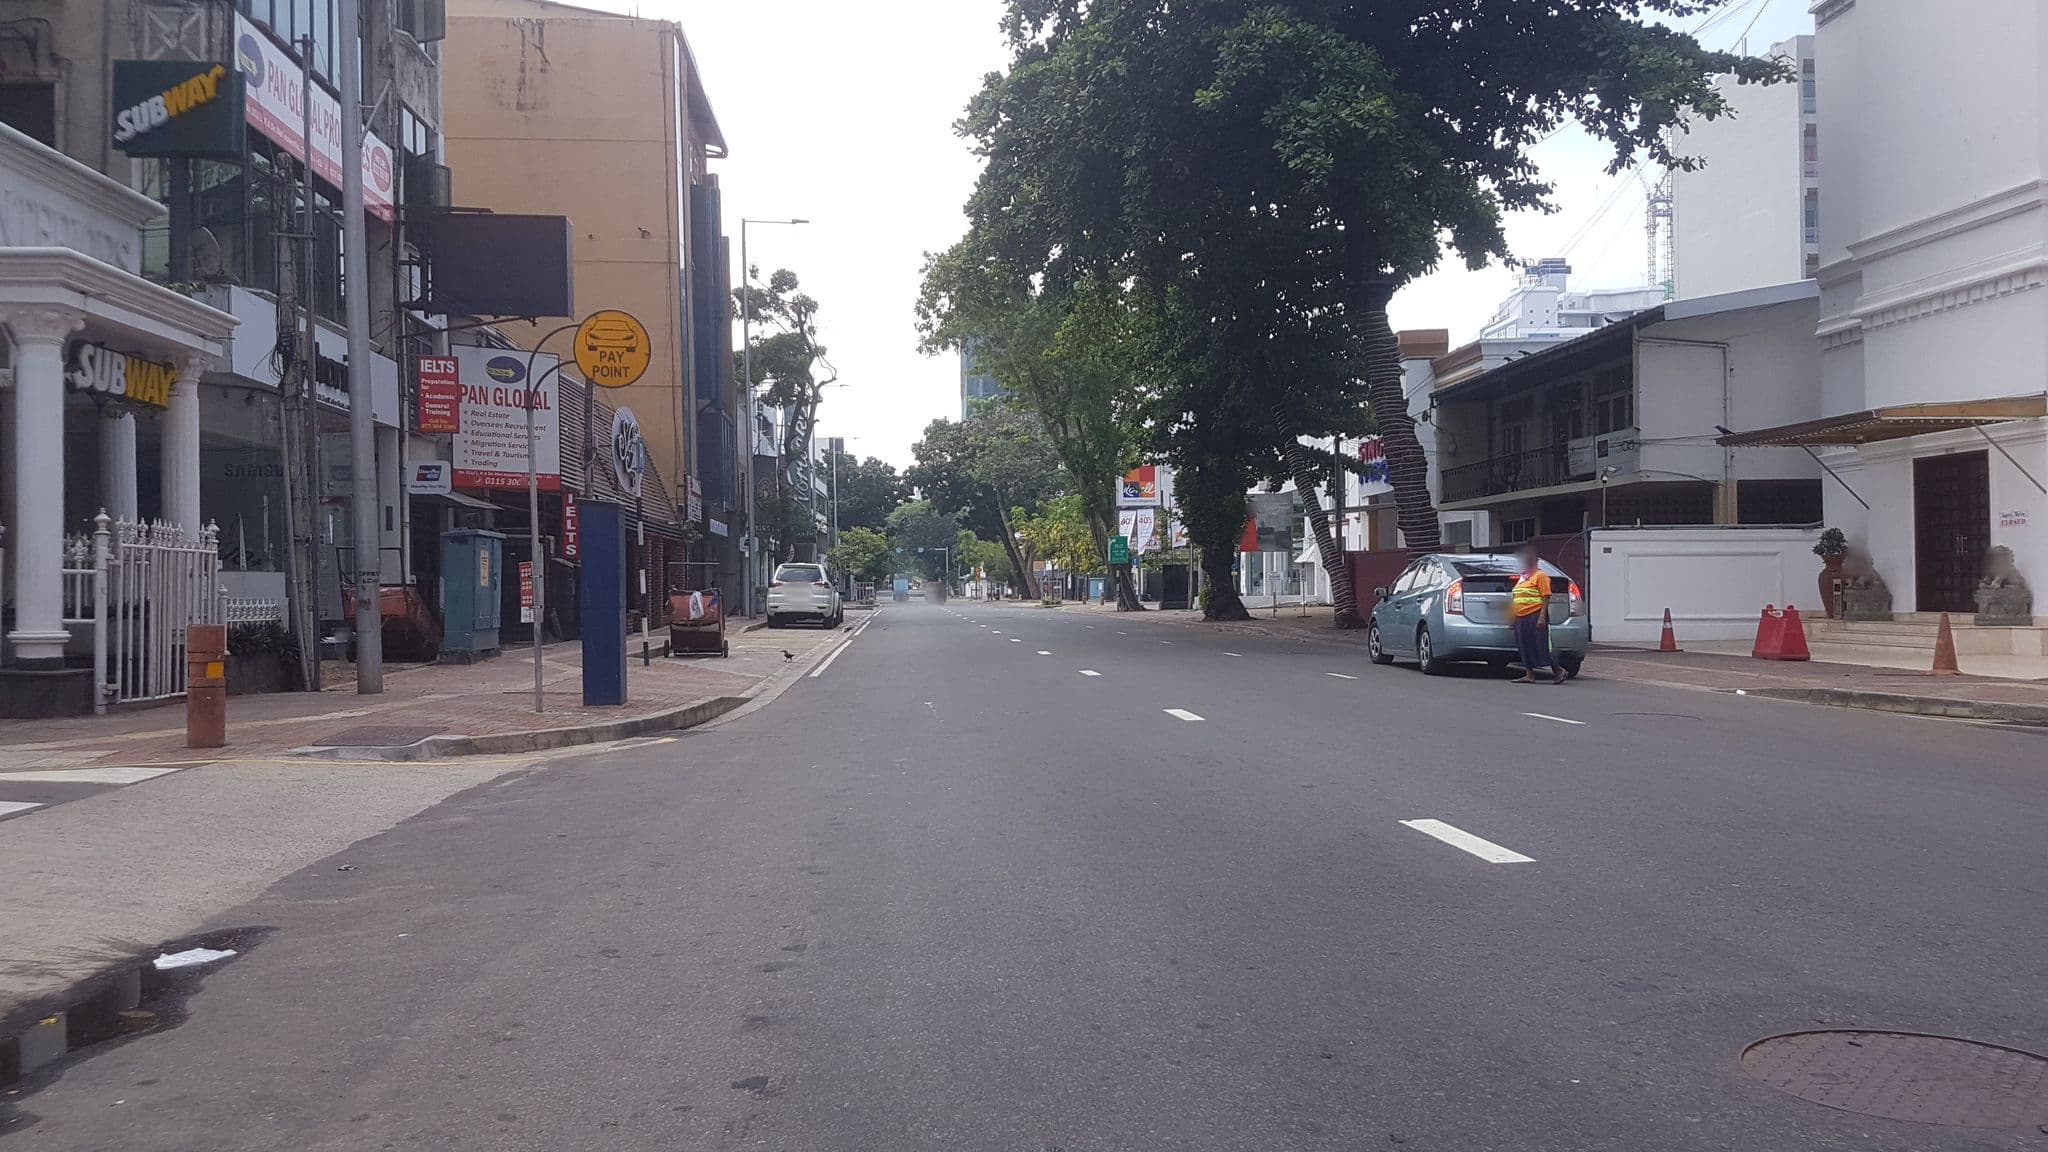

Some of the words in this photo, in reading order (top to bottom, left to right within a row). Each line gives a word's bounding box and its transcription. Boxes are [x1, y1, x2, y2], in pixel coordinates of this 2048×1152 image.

[113, 63, 225, 143] SUBWAY
[267, 60, 287, 106] PAN
[288, 79, 323, 137] GLOAL
[599, 350, 625, 364] PAY
[420, 359, 455, 374] IELTS
[592, 365, 630, 378] POINT
[65, 343, 176, 408] SUBWAY
[459, 384, 489, 406] PAN
[470, 409, 487, 417] Real
[488, 411, 510, 419] Estate
[470, 420, 503, 429] Overseas
[504, 423, 546, 432] Recruient
[470, 430, 512, 439] Educational
[513, 432, 541, 441] Serves
[470, 440, 507, 449] Migration
[507, 442, 529, 450] Servic
[470, 449, 493, 457] Travel
[502, 451, 529, 459] Tourism
[470, 459, 499, 468] Trading
[223, 463, 309, 478] SAMSU
[485, 477, 505, 486] 0115
[565, 493, 577, 555] IELTS
